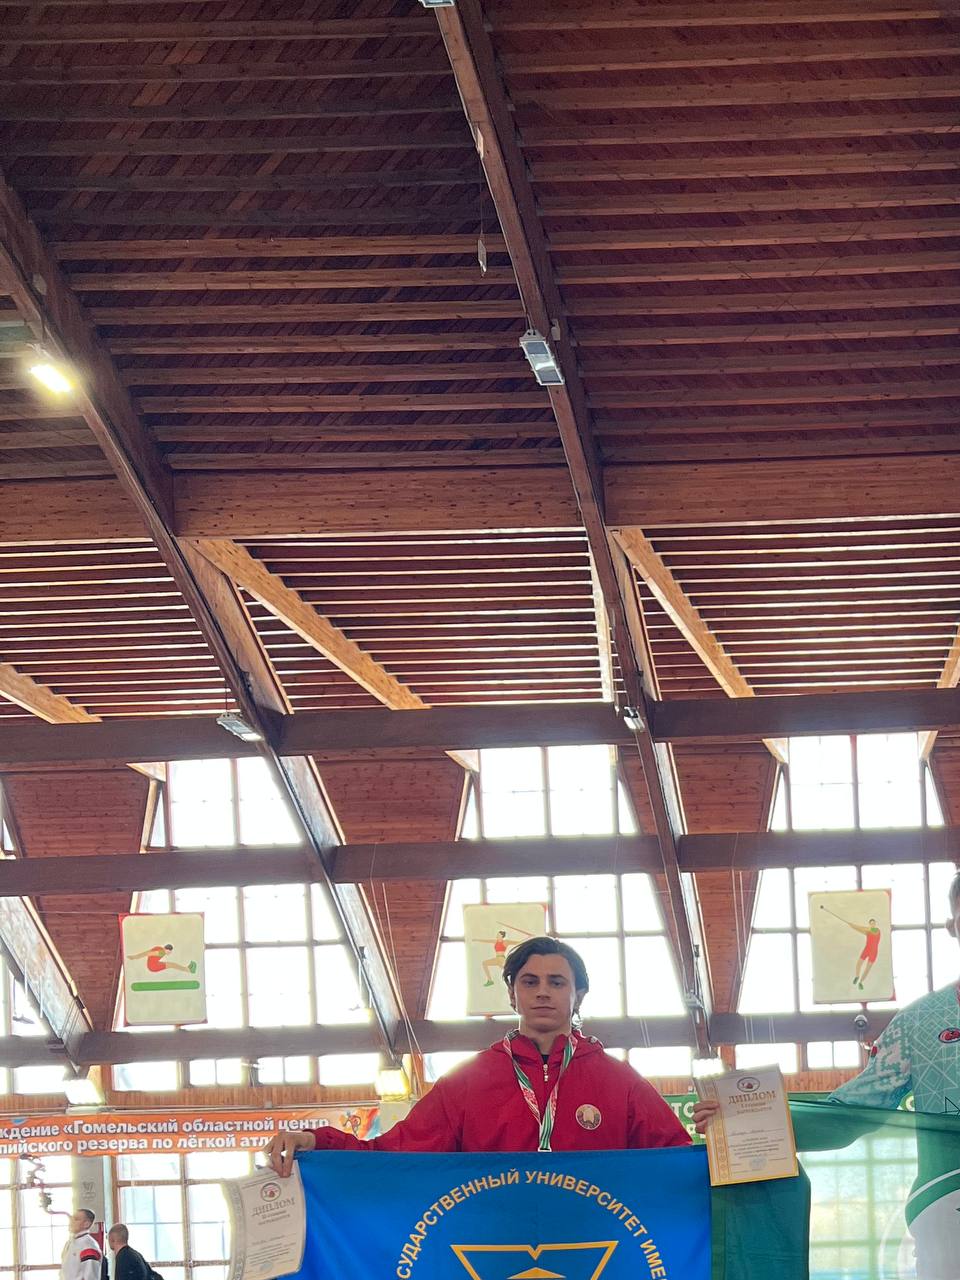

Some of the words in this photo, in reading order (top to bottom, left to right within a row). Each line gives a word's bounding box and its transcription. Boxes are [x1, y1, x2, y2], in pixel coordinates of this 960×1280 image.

[728, 1090, 776, 1105] ДИПЛОМ
[63, 1118, 178, 1135] «Гомельский
[182, 1117, 274, 1133] областной
[77, 1137, 148, 1154] резерва
[152, 1138, 173, 1149] по
[177, 1133, 237, 1149] лёгкой
[240, 1136, 273, 1148] атл
[251, 1197, 296, 1217] ДИПЛОМ
[525, 1170, 648, 1239] УНИВЕРСИТЕТ
